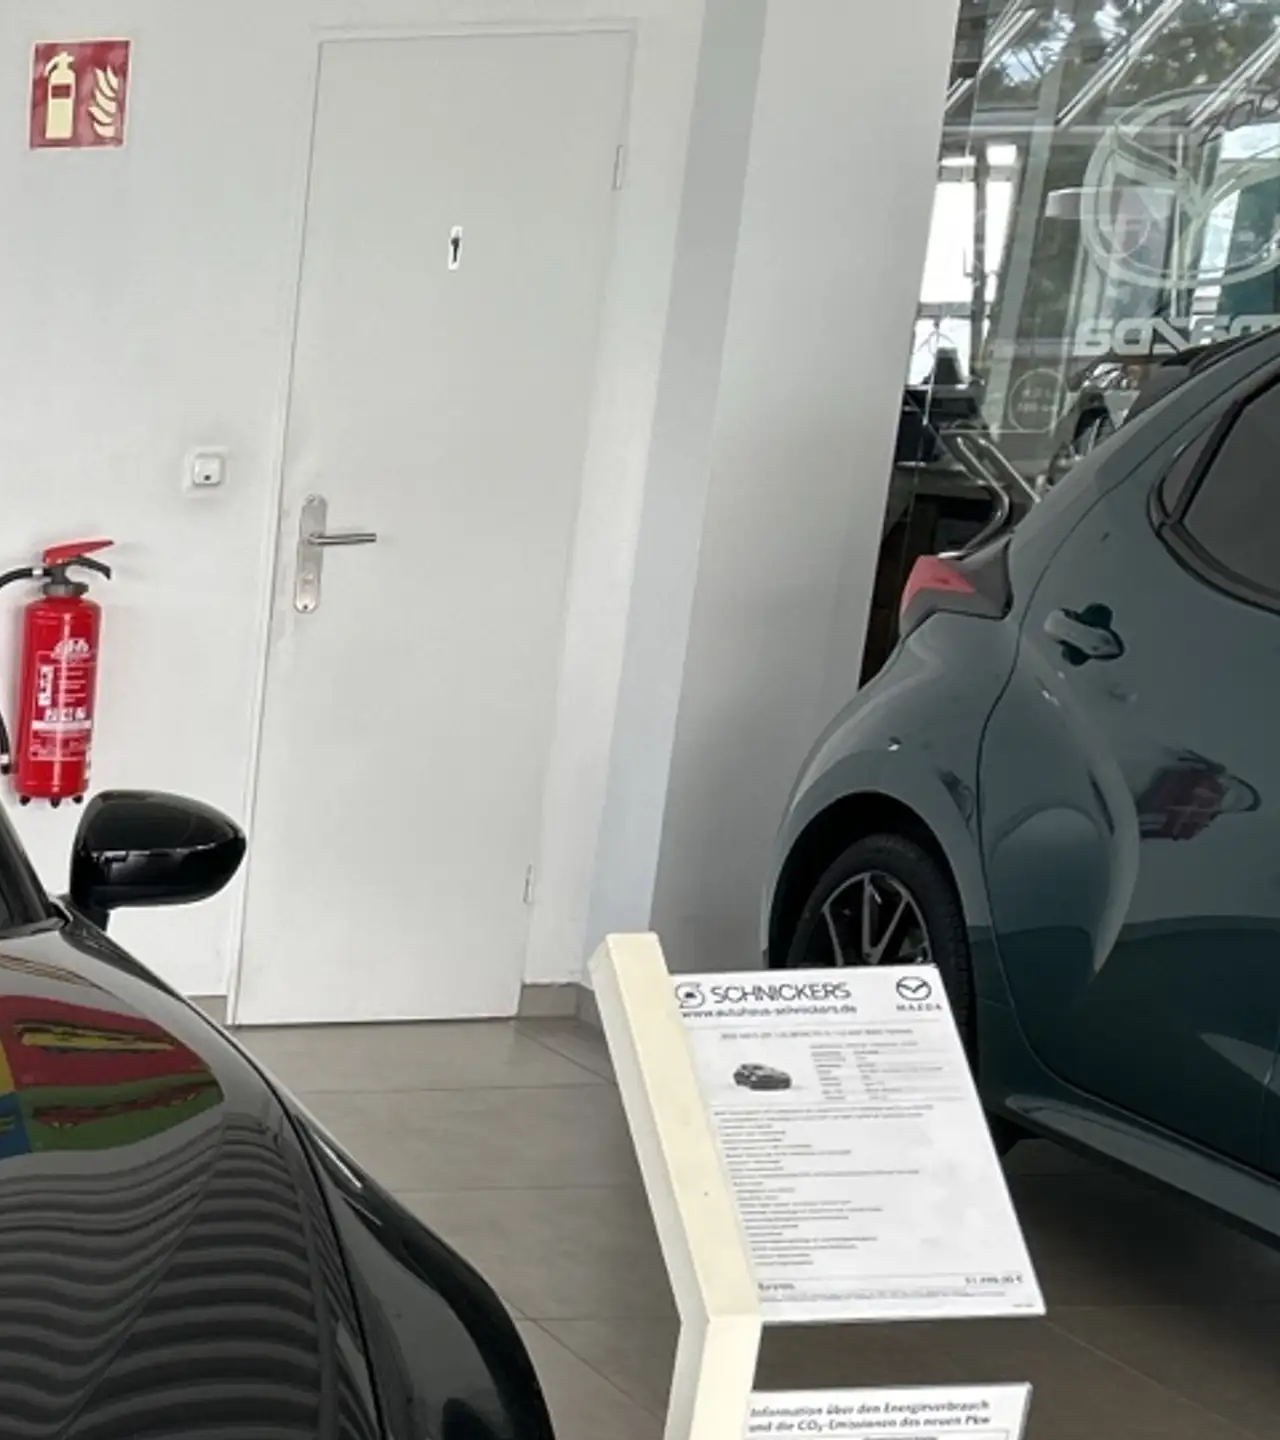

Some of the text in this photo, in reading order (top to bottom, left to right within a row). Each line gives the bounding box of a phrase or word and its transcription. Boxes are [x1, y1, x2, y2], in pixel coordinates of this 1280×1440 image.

[709, 982, 852, 1004] SCHNICKERS
[682, 1003, 857, 1019] www.autohaus-schnickers.de
[857, 1403, 881, 1415] den
[883, 1400, 990, 1415] Energieverbrauch
[775, 1419, 795, 1431] die
[924, 1417, 963, 1427] neuen
[965, 1414, 991, 1426] Pkw
